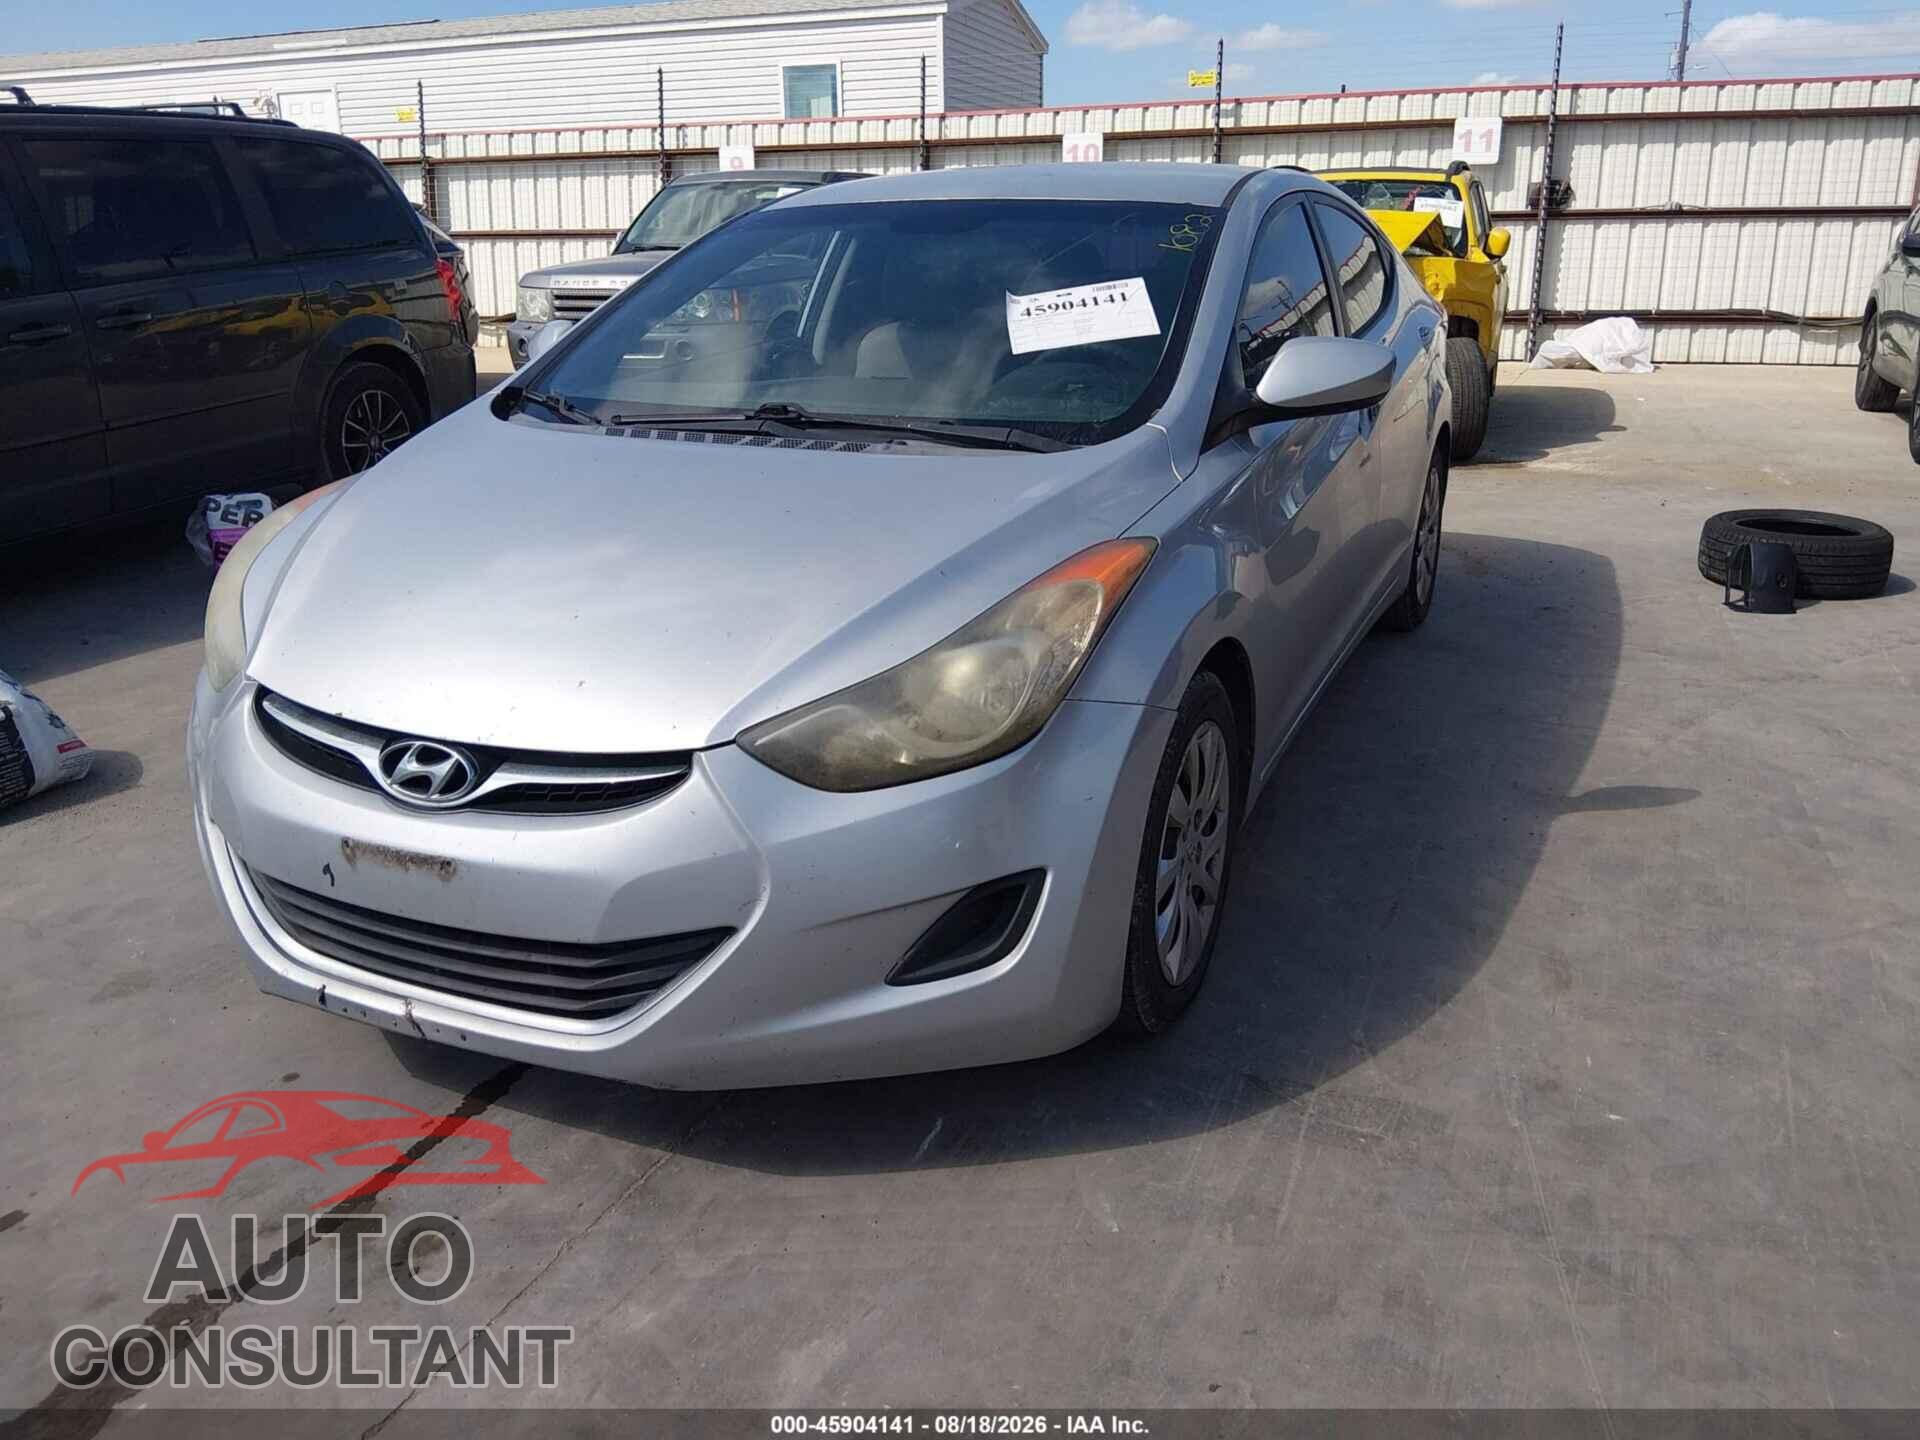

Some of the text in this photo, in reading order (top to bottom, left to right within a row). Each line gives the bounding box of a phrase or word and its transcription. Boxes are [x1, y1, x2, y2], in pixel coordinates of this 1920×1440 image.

[1066, 143, 1100, 162] 10
[1458, 128, 1494, 153] 11
[1020, 291, 1129, 318] 45904141
